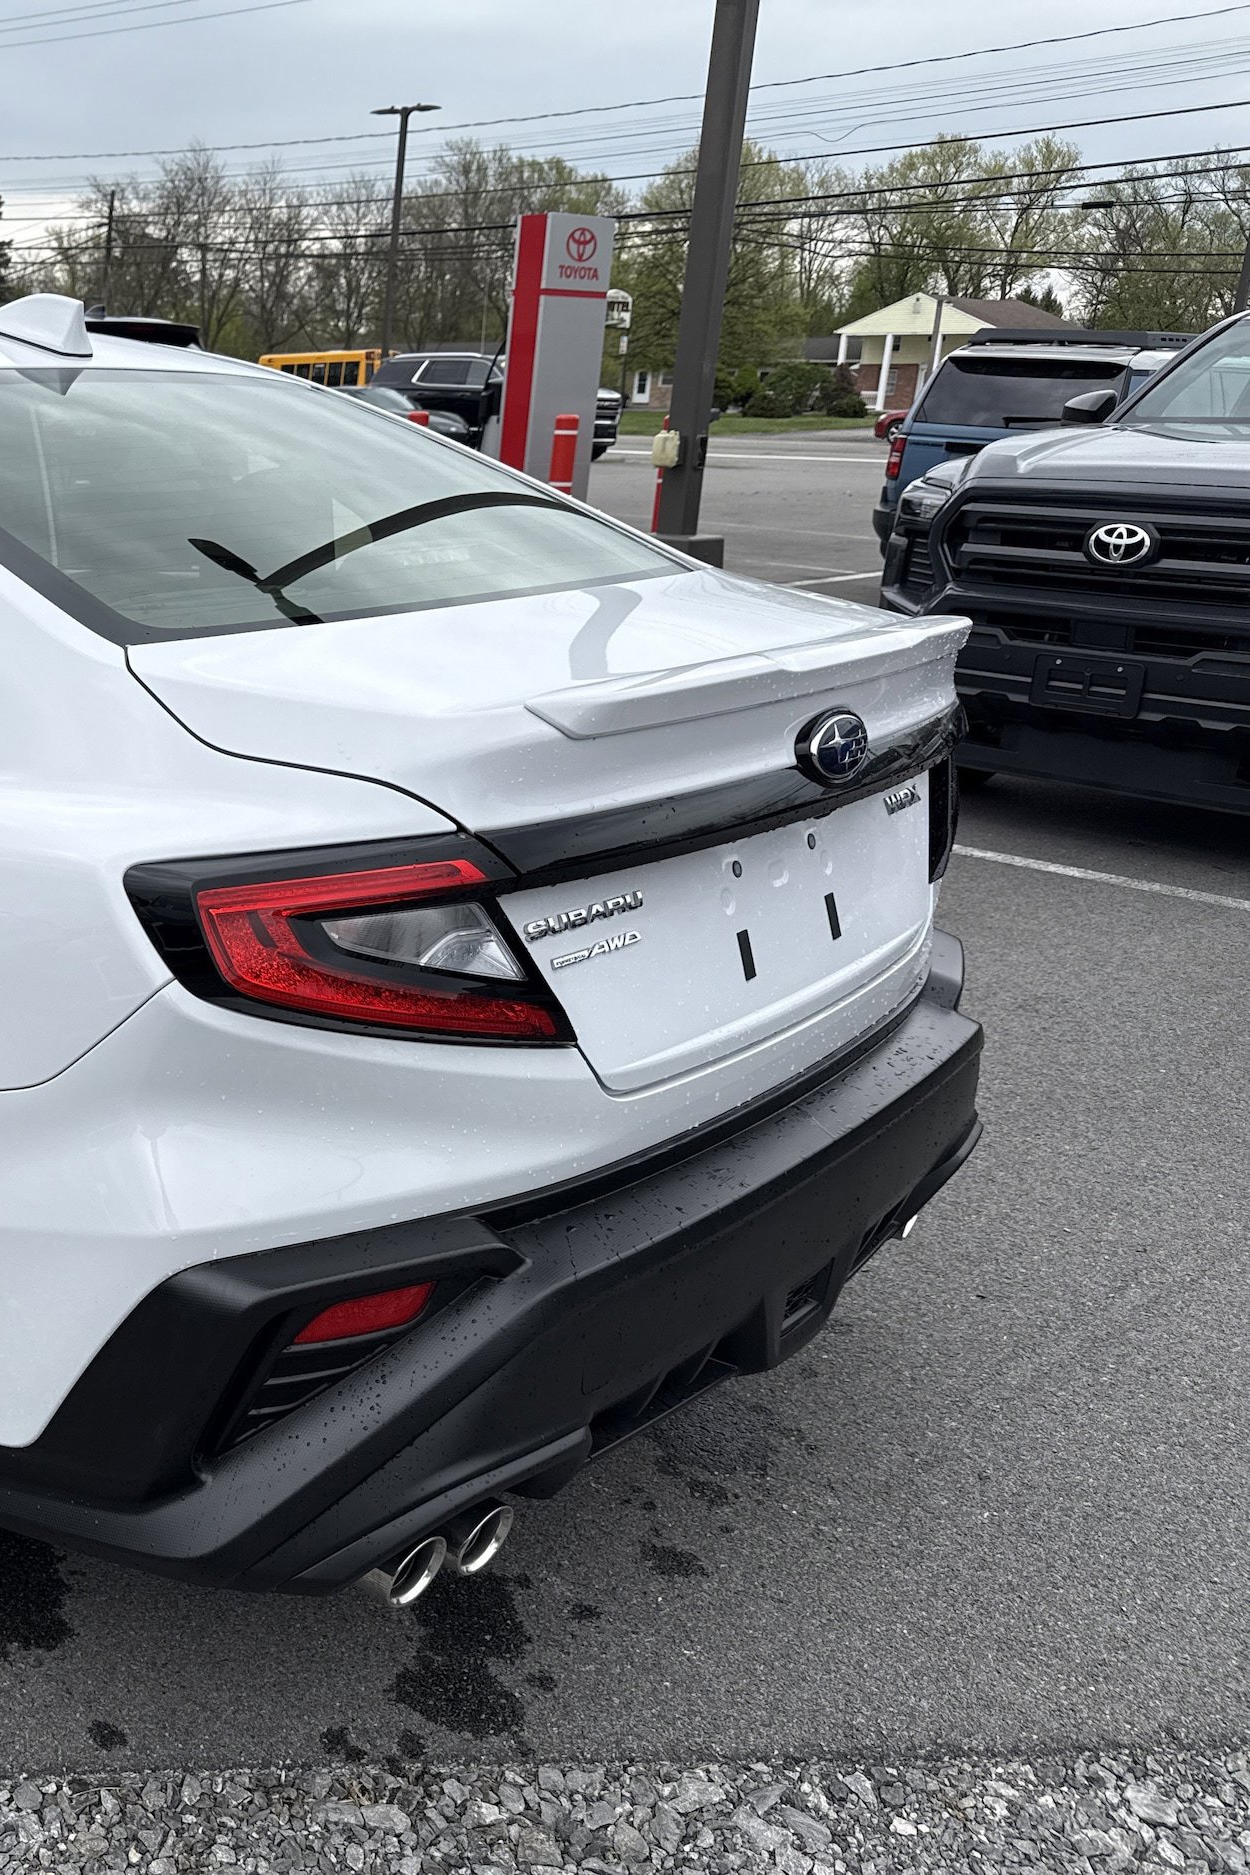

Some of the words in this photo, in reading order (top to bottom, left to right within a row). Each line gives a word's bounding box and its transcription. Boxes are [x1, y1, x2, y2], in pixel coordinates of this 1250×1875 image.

[558, 264, 599, 281] TOYOTA
[883, 783, 921, 816] WRX
[523, 889, 644, 943] SUBARU
[590, 930, 642, 958] AWD
